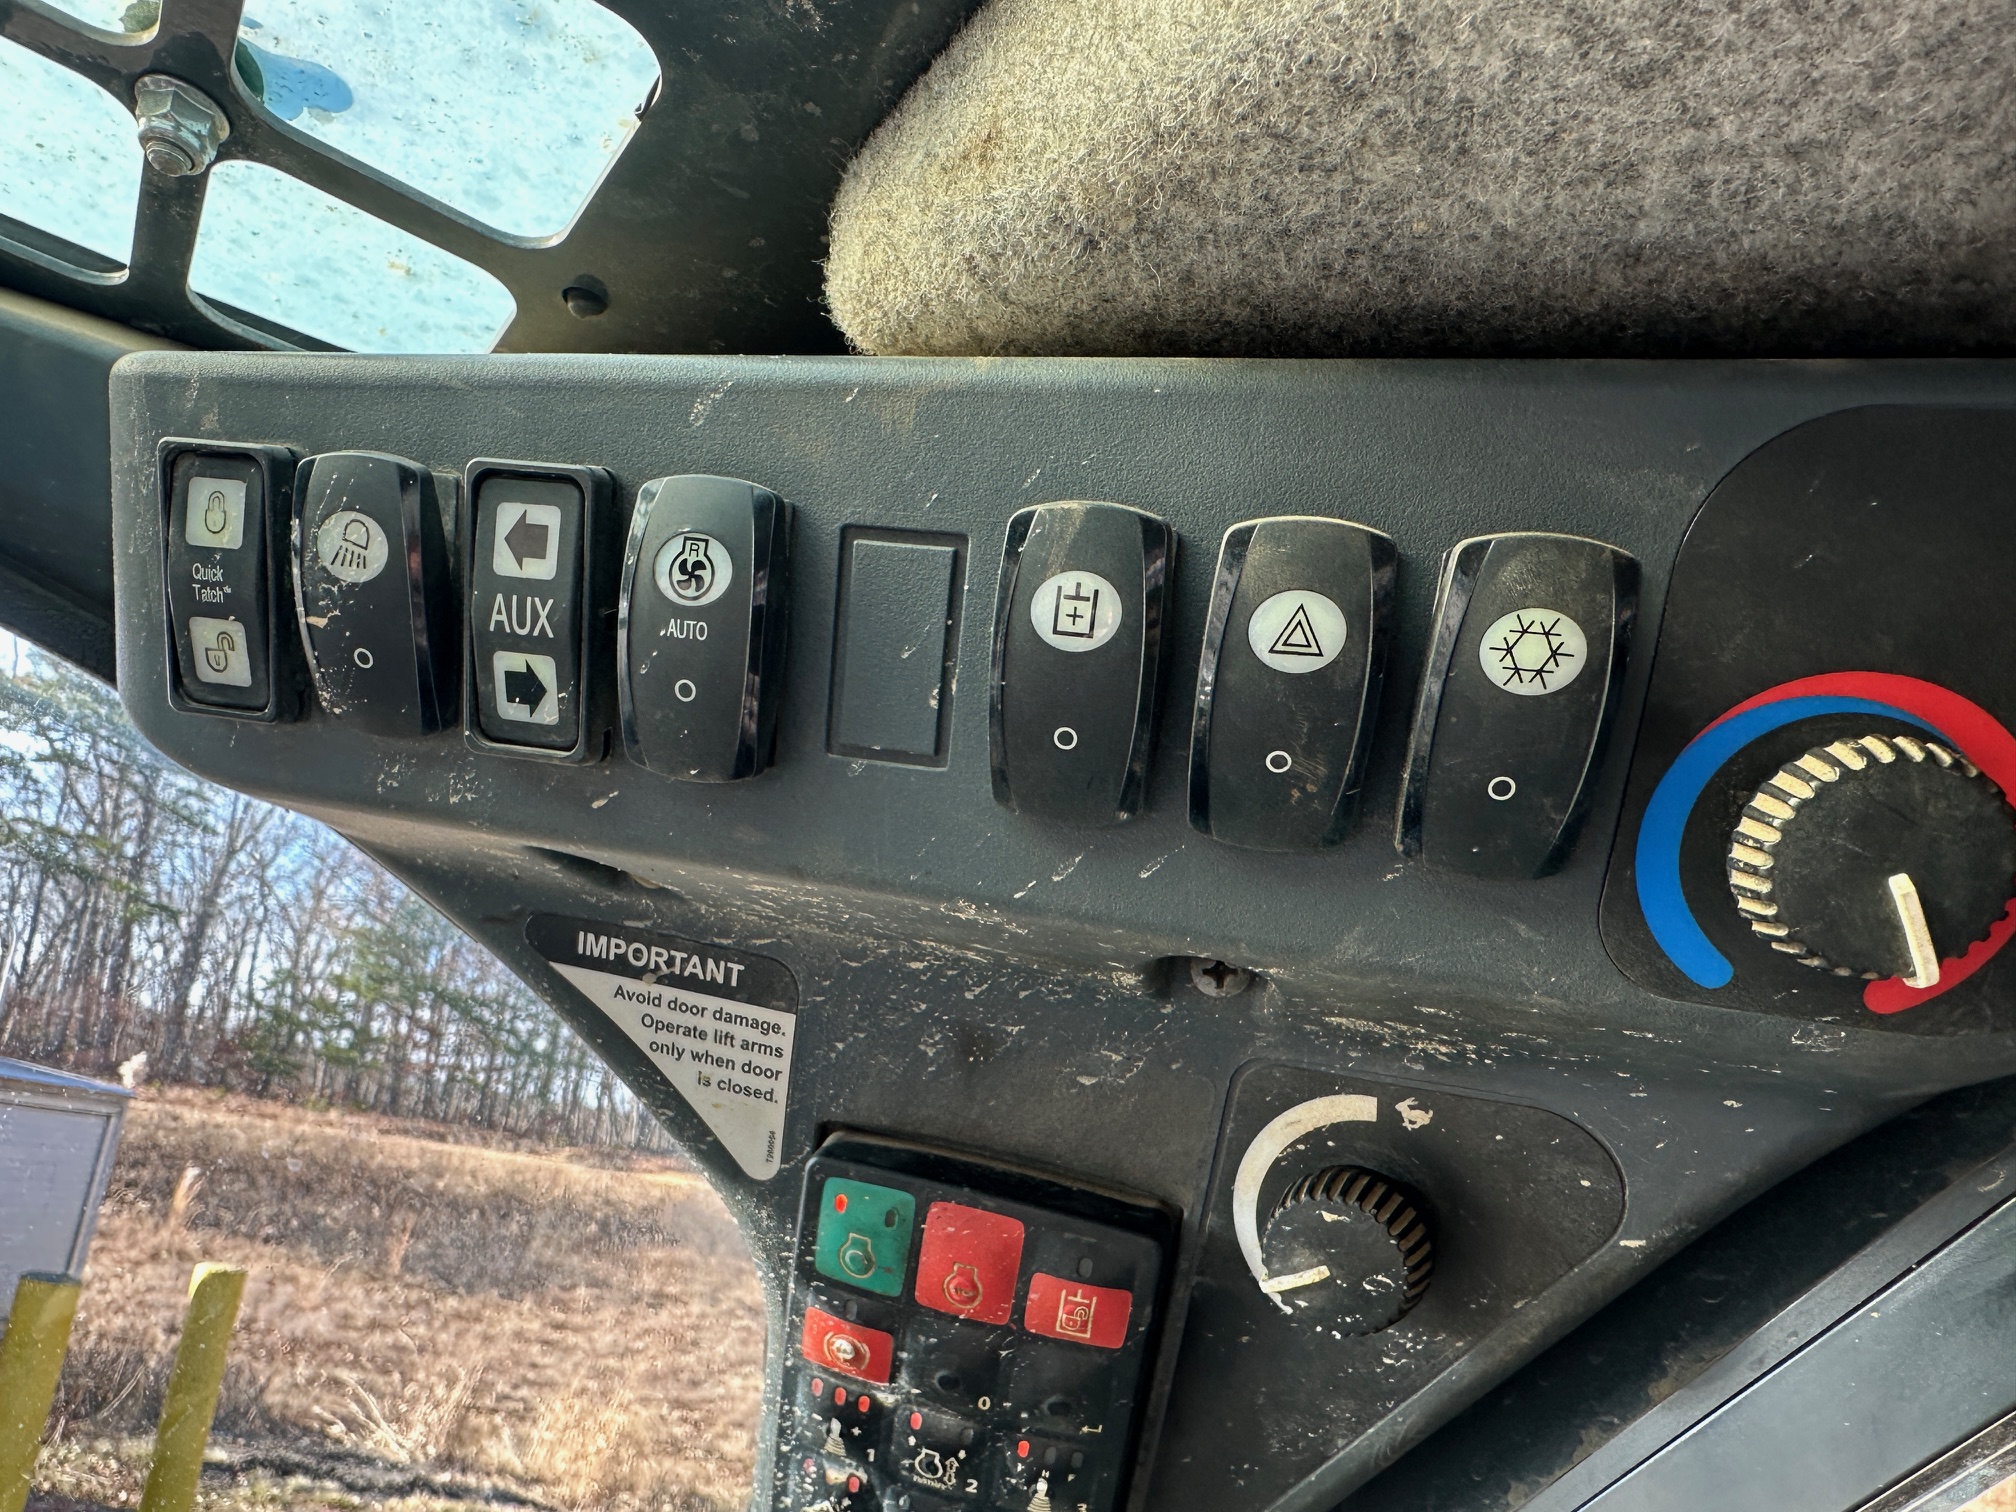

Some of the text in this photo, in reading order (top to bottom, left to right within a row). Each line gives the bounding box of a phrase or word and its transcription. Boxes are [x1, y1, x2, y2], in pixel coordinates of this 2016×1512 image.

[192, 563, 224, 582] Quick
[489, 593, 554, 638] AUX
[667, 619, 708, 641] AUTO
[577, 930, 745, 987] IMPORTANT
[613, 984, 786, 1037] Avoid door damage.
[641, 1013, 784, 1059] Operate lift arms
[649, 1040, 783, 1082] only when door
[697, 1071, 778, 1104] is closed.
[978, 1396, 991, 1411] 0
[867, 1449, 876, 1463] 1
[965, 1479, 978, 1494] 2
